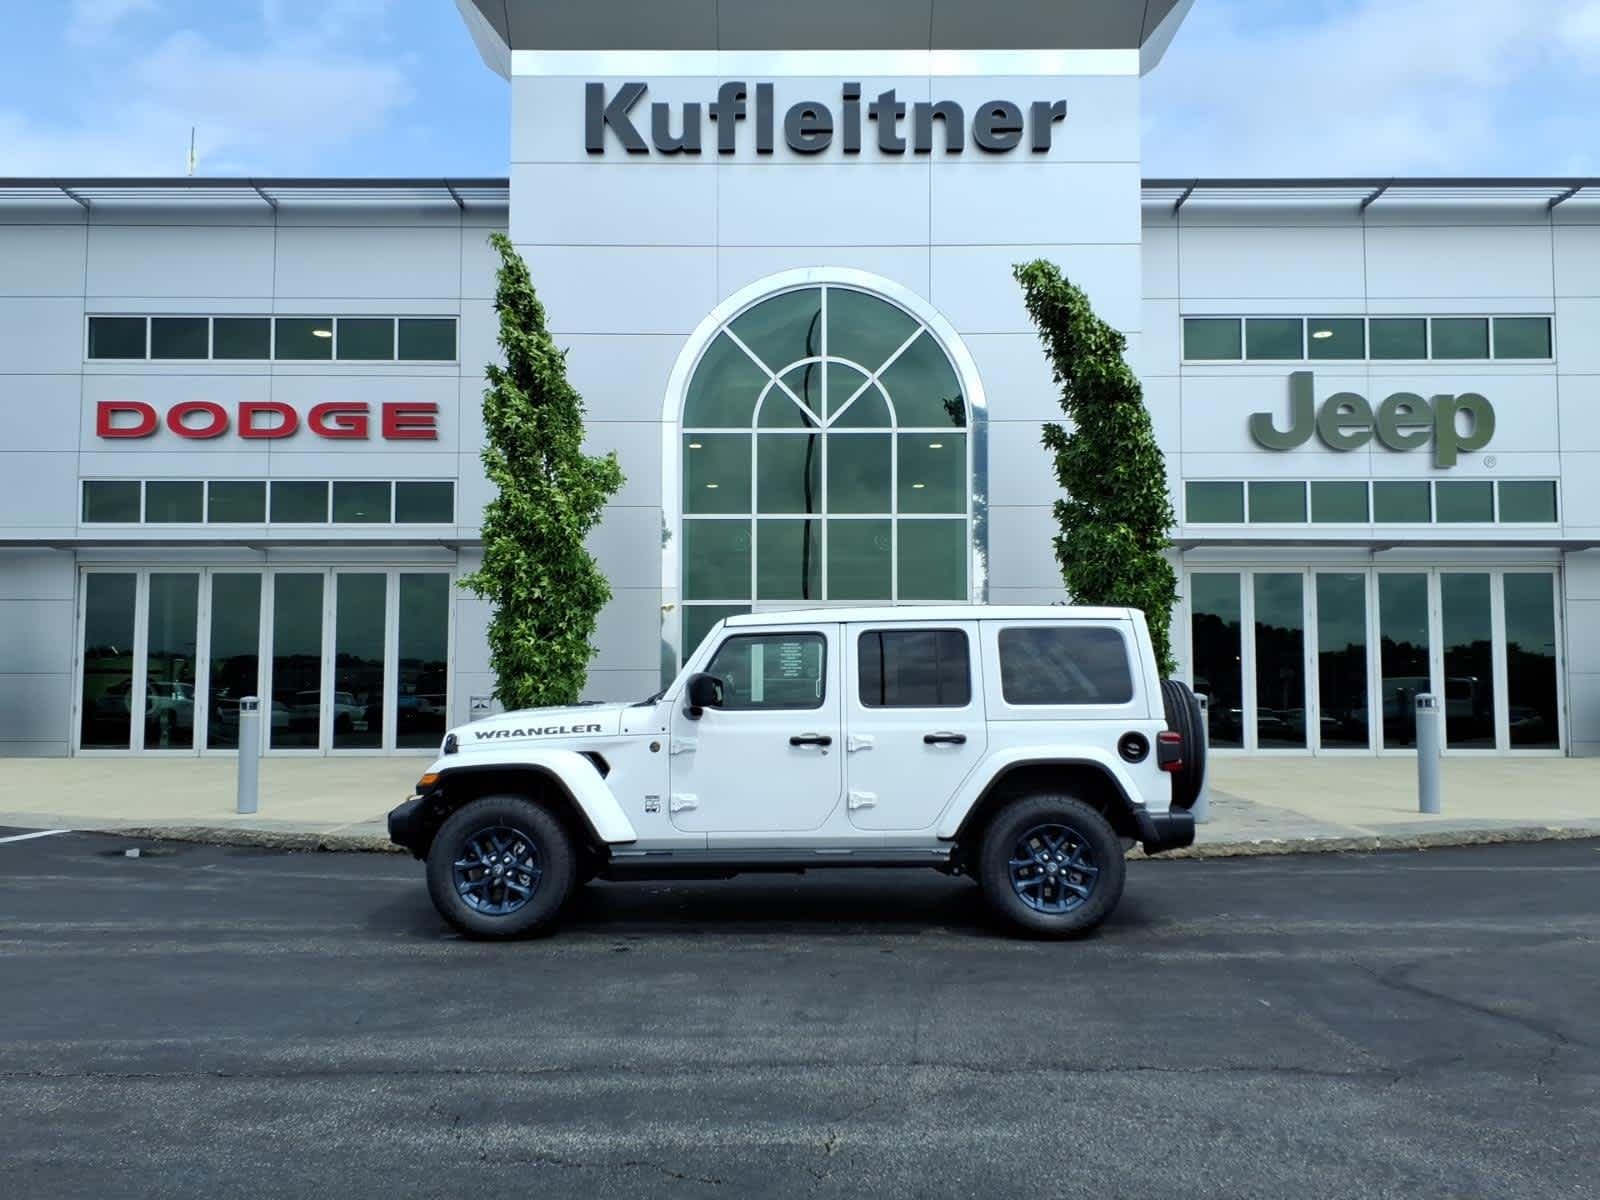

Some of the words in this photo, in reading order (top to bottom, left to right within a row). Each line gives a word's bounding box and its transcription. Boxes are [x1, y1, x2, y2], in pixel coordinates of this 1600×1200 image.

[585, 81, 1067, 155] Kufleitner
[96, 401, 439, 440] DODGE
[1249, 371, 1496, 469] Jeep
[475, 724, 602, 739] WRANGLER
